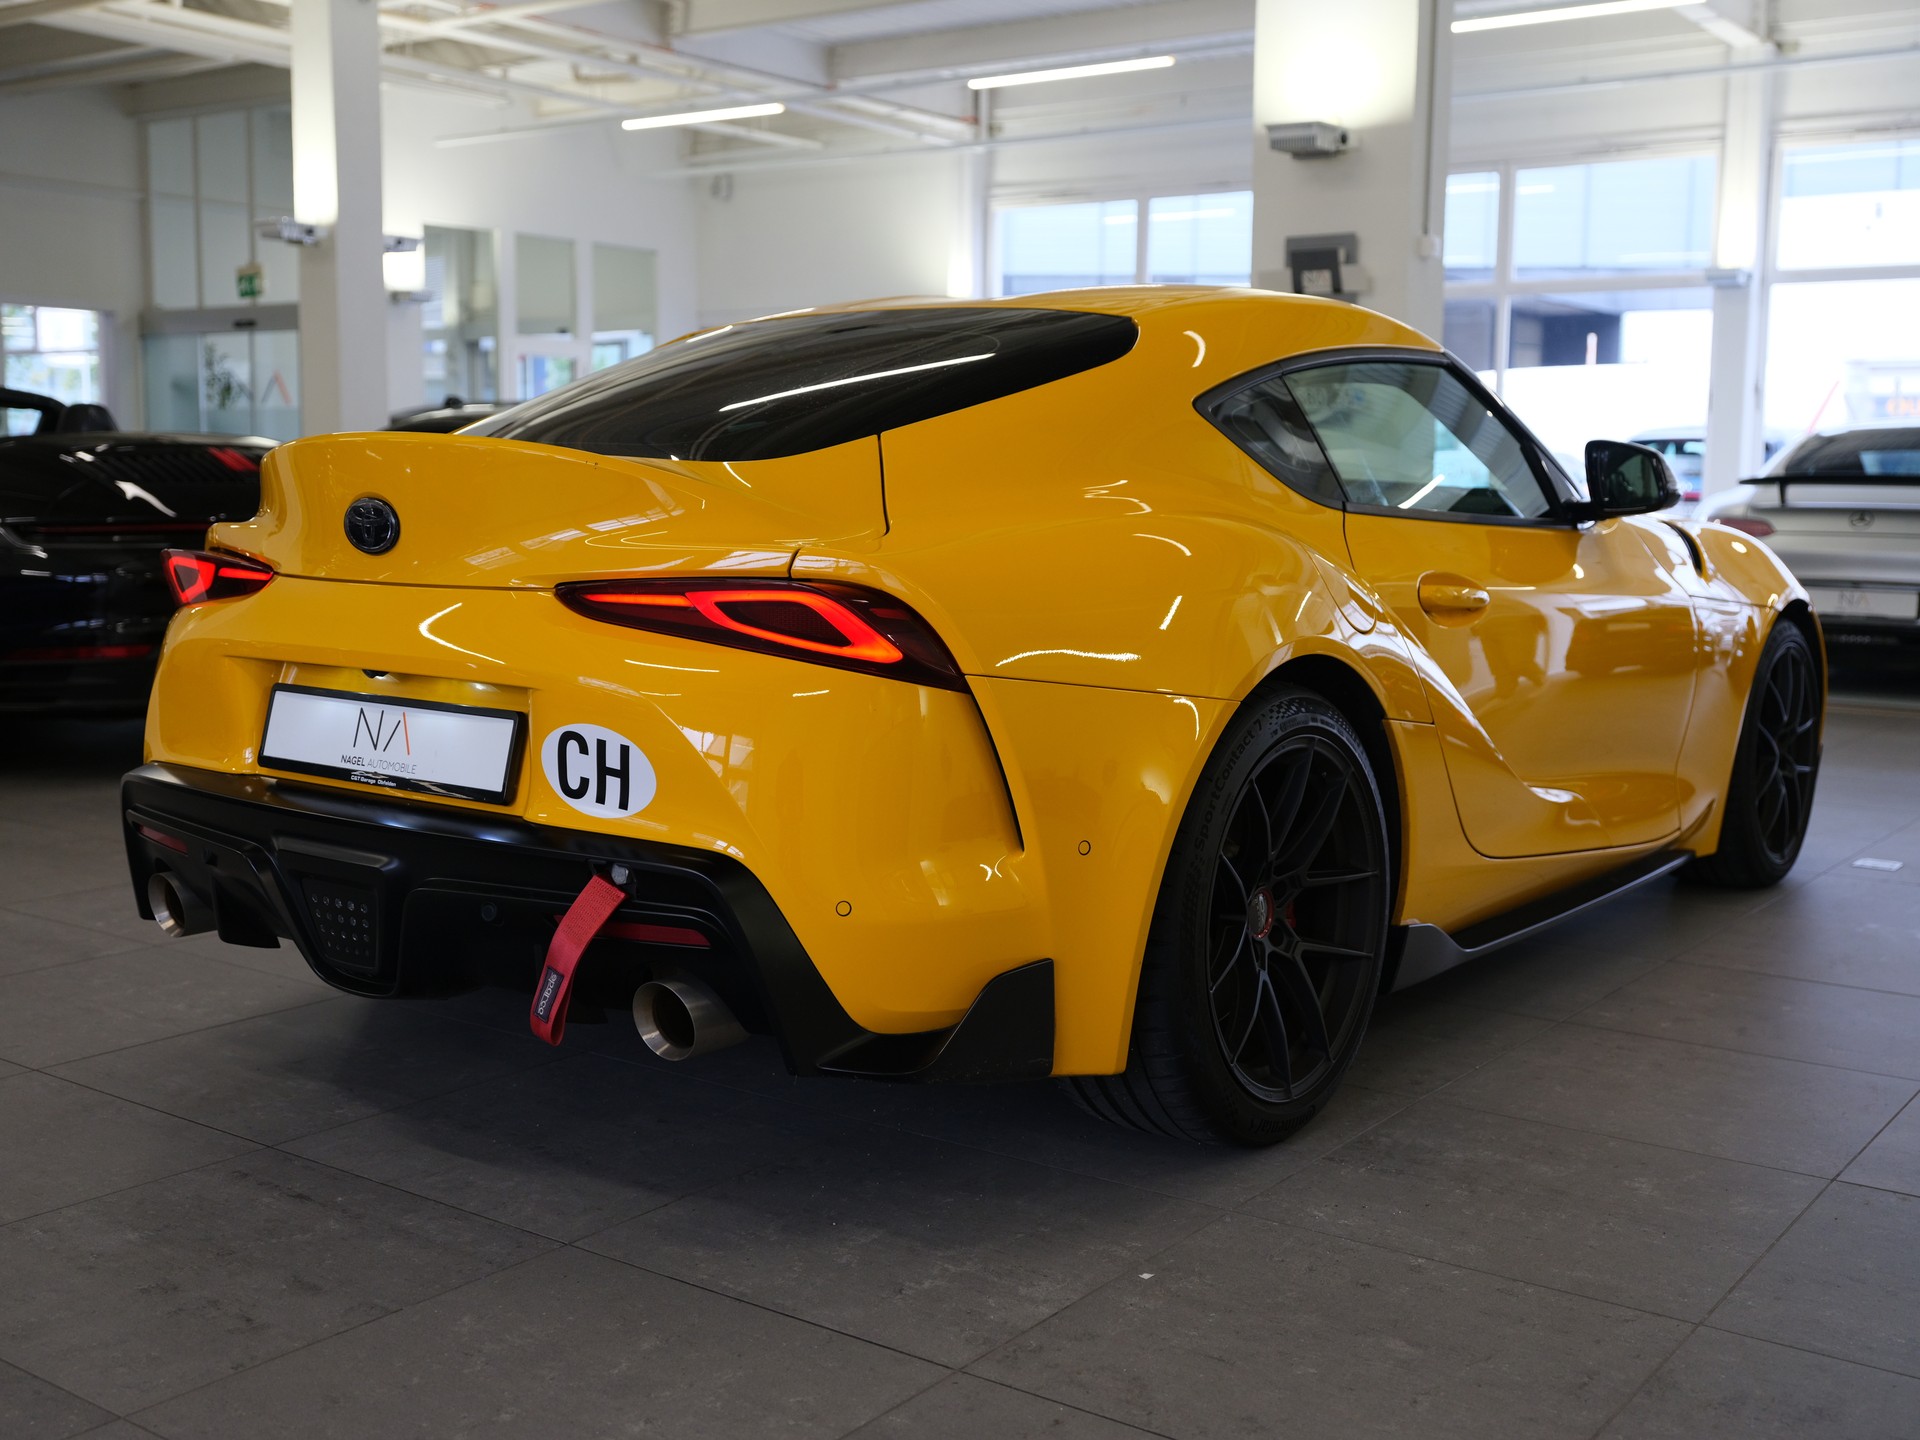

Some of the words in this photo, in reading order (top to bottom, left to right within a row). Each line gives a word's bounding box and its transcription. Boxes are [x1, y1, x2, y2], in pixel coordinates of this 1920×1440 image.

[341, 755, 365, 767] NAGEL
[367, 760, 417, 774] AUTOMOBILE
[558, 731, 630, 811] CH
[1193, 729, 1258, 853] SportContact
[1254, 717, 1264, 731] 7
